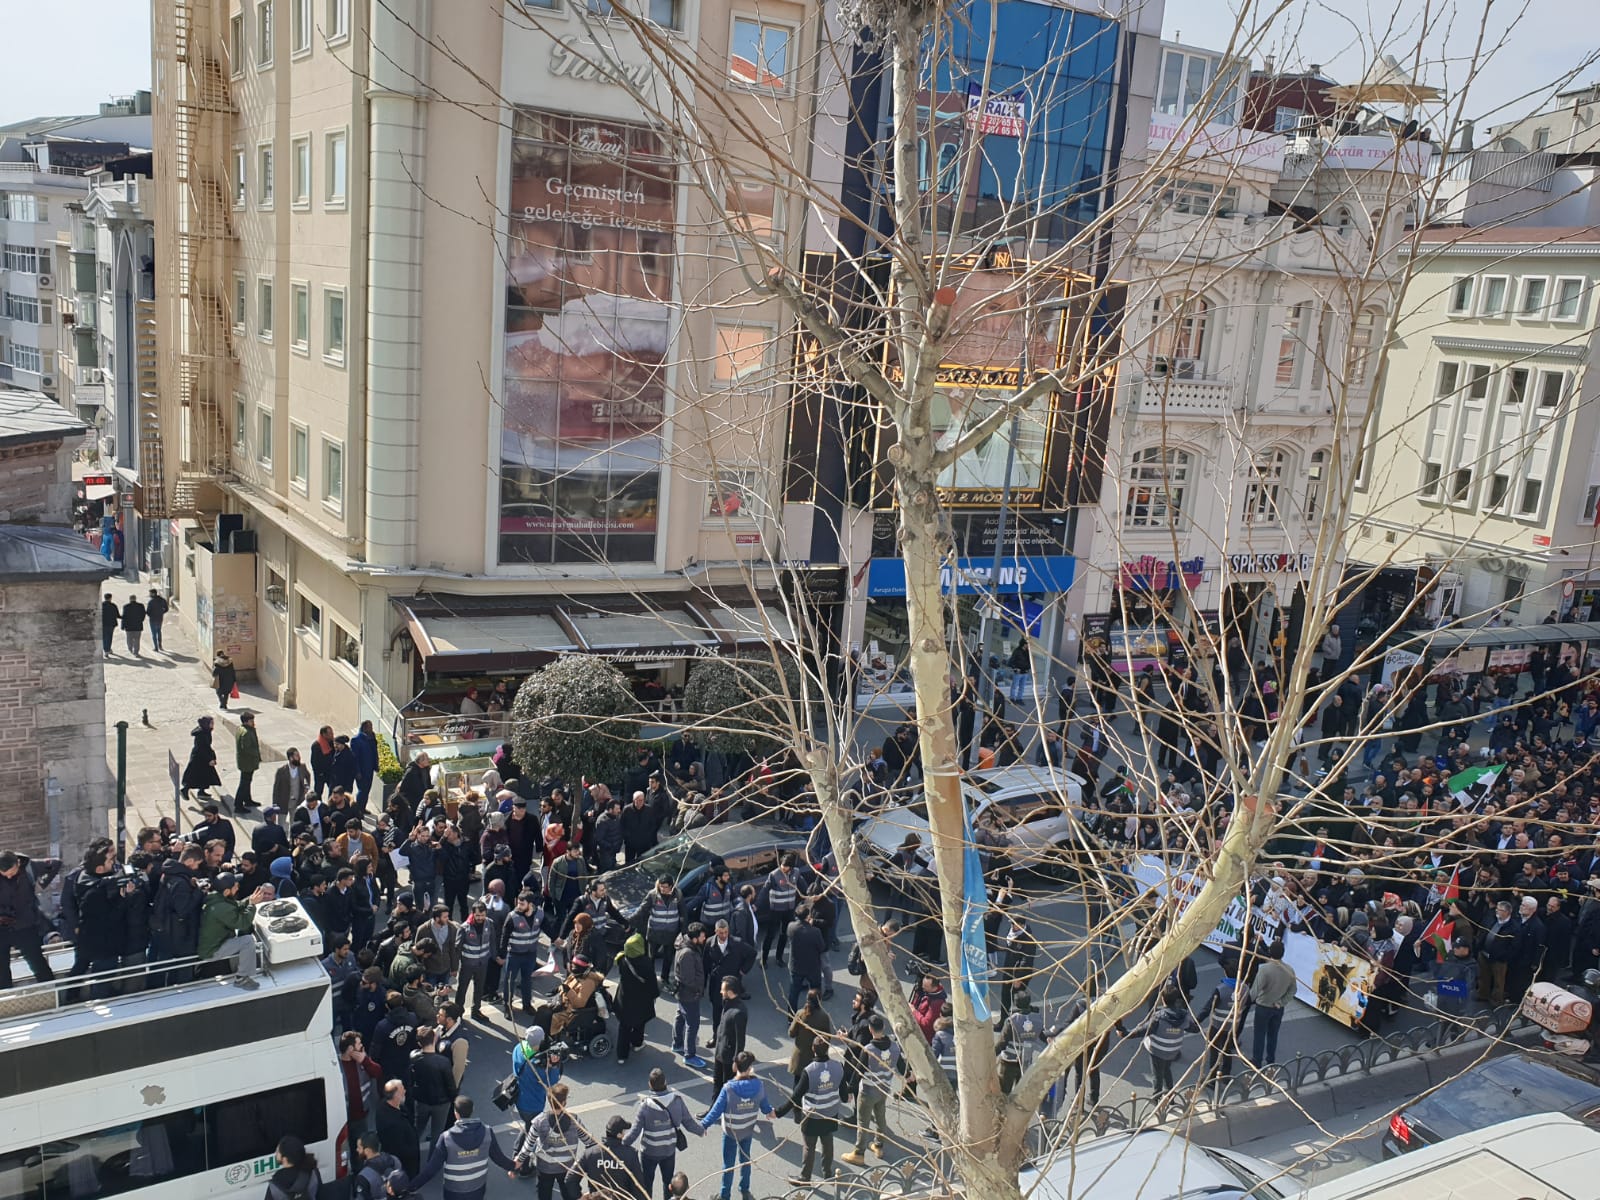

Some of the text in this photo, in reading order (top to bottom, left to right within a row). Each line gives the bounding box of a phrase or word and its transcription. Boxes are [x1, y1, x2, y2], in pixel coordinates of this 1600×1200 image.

[969, 97, 1024, 119] KRALK
[1367, 149, 1402, 160] TEM
[546, 177, 645, 205] Geçmişten
[524, 203, 603, 230] geleceğe
[970, 493, 1011, 503] MOD
[940, 567, 1027, 586] AMSNG
